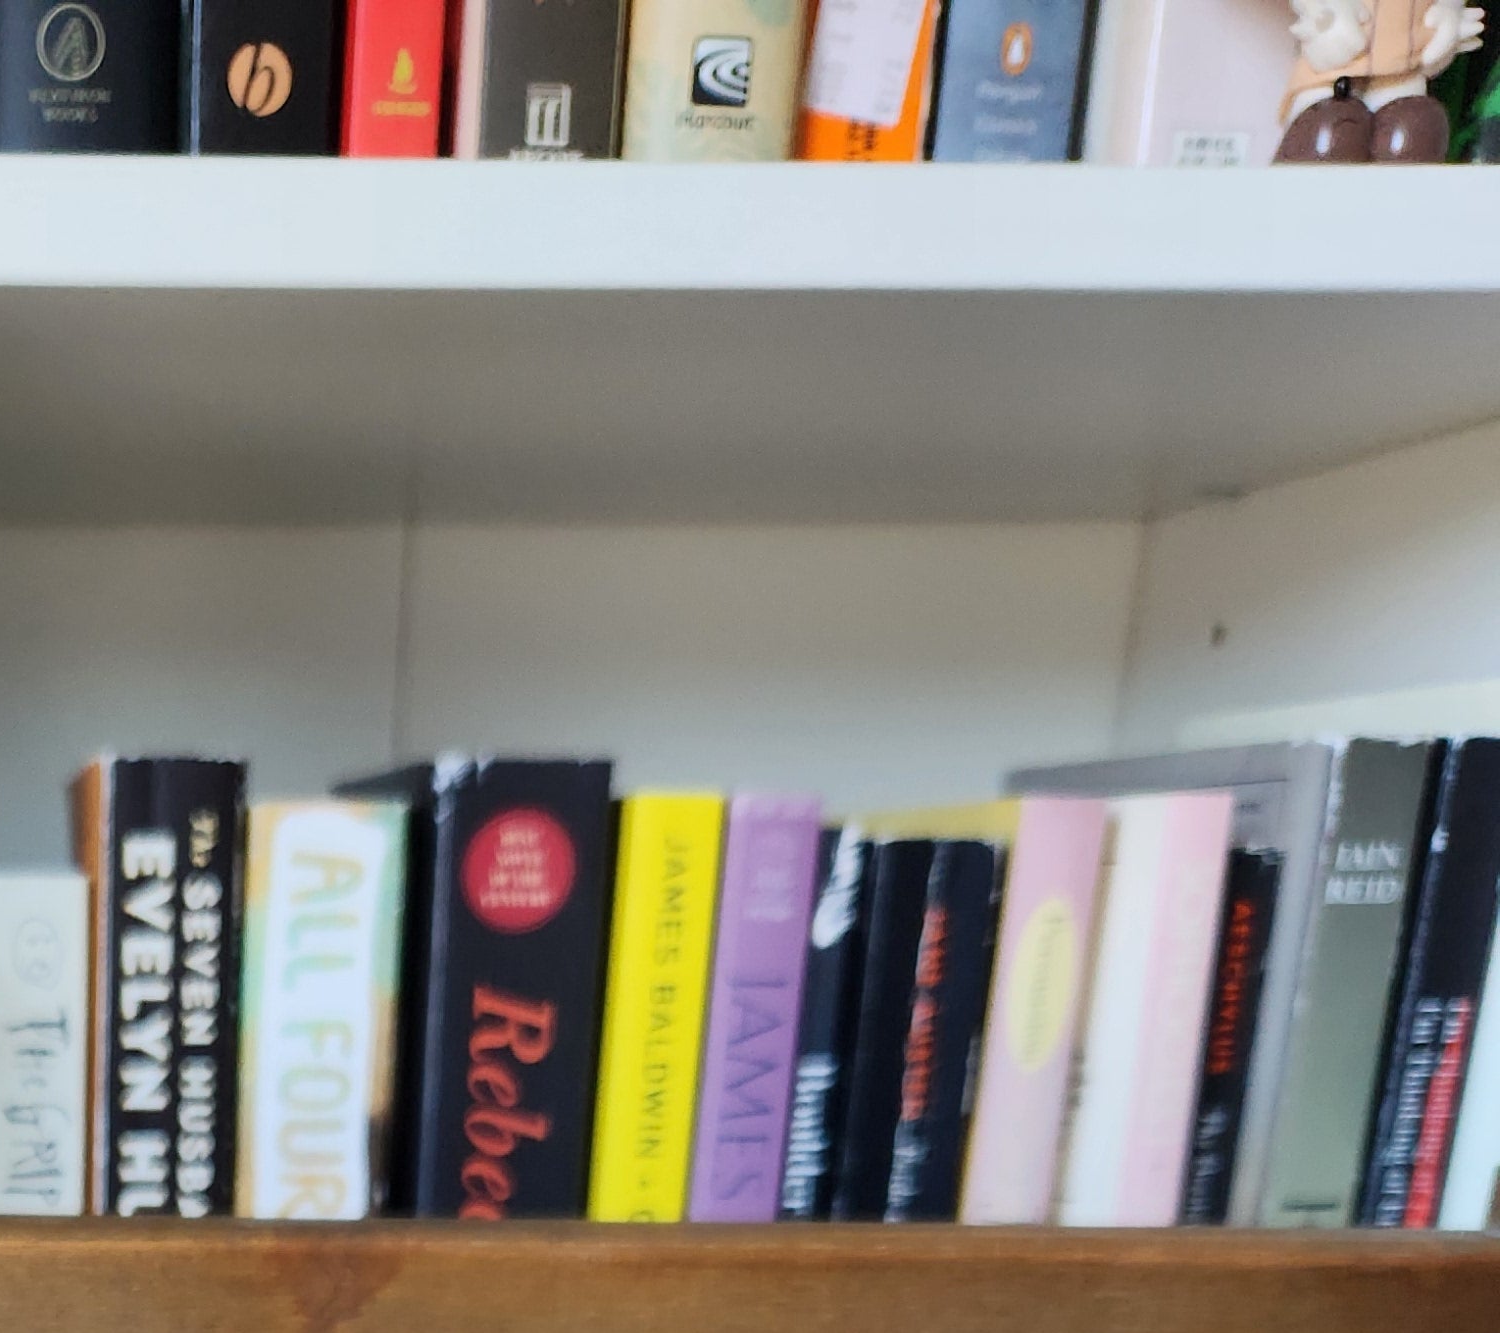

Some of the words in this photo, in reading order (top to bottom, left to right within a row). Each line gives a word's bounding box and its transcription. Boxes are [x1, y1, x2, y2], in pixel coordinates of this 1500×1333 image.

[118, 827, 177, 1115] EVELYN
[179, 874, 223, 1047] SEVEN
[285, 846, 365, 997] ALL
[653, 832, 690, 970] JAMES
[633, 983, 677, 1161] BALDWIN
